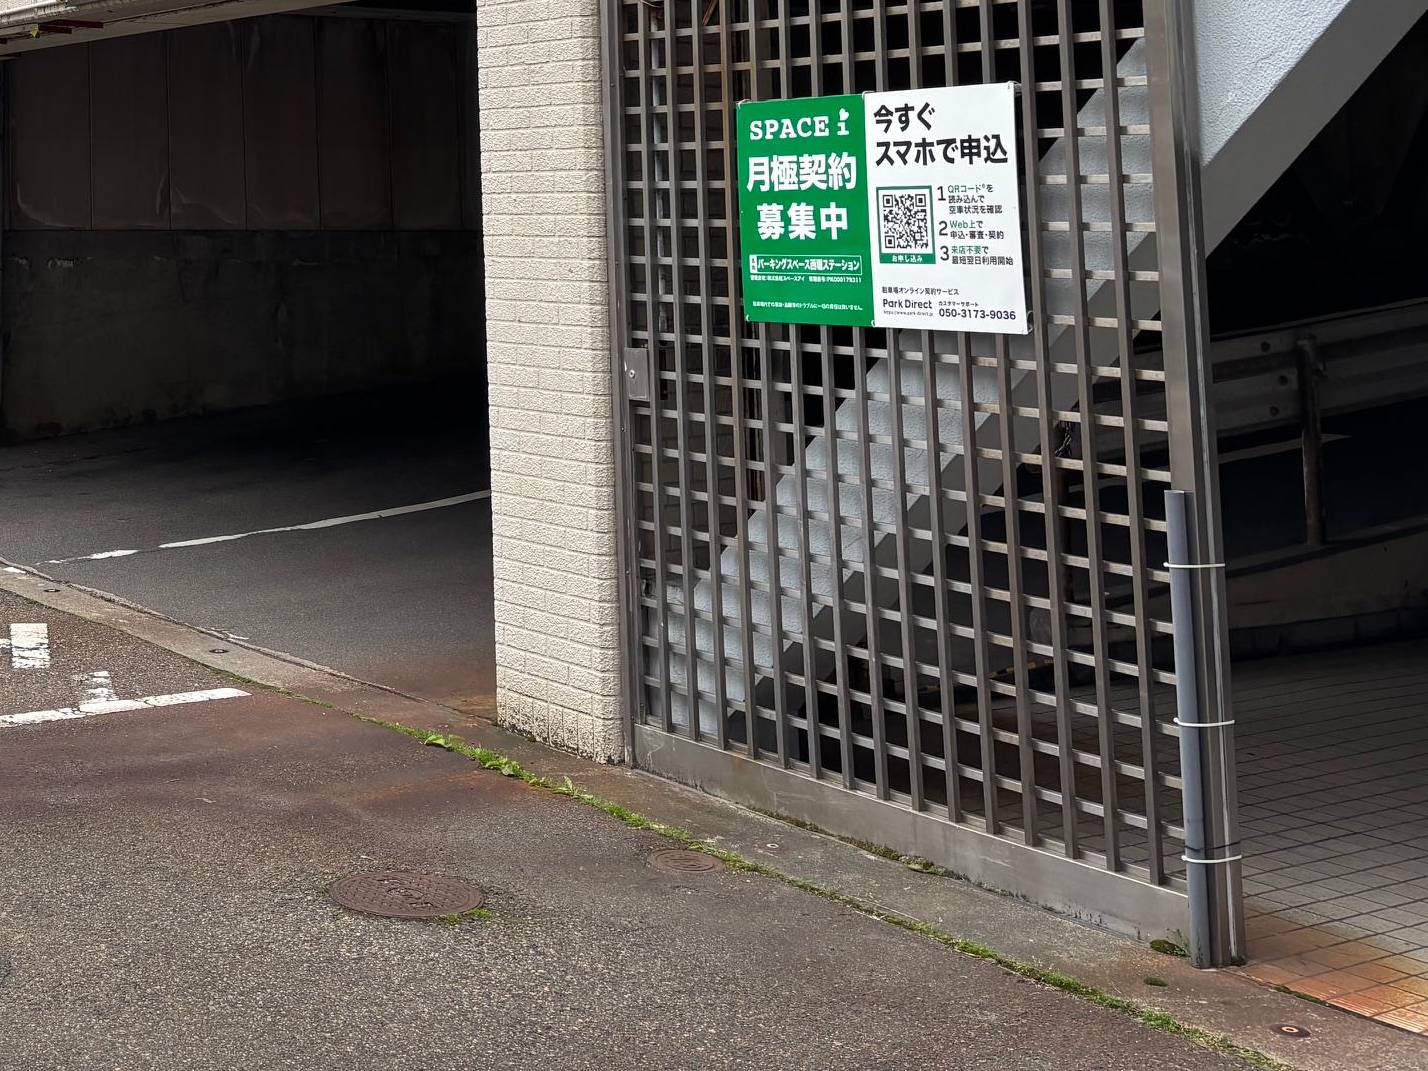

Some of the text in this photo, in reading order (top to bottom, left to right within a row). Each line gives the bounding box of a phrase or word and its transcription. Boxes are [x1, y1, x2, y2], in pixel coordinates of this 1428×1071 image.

[873, 101, 935, 133] 今すぐ
[749, 115, 829, 141] SPACE
[875, 133, 1008, 167] スマホで申込
[746, 151, 857, 192] 月極契約
[937, 186, 946, 201] 1
[948, 195, 985, 204] 読み込んで
[948, 205, 1003, 214] 空車状況を確認
[756, 201, 848, 241] 募集中
[938, 221, 948, 236] 2
[949, 220, 984, 229] Web上で
[940, 245, 950, 261] 3
[951, 245, 989, 255] 来店不要で
[891, 255, 923, 263] お申し込み
[882, 299, 933, 309] Park Direct
[938, 308, 1016, 320] 050-3173-9036
